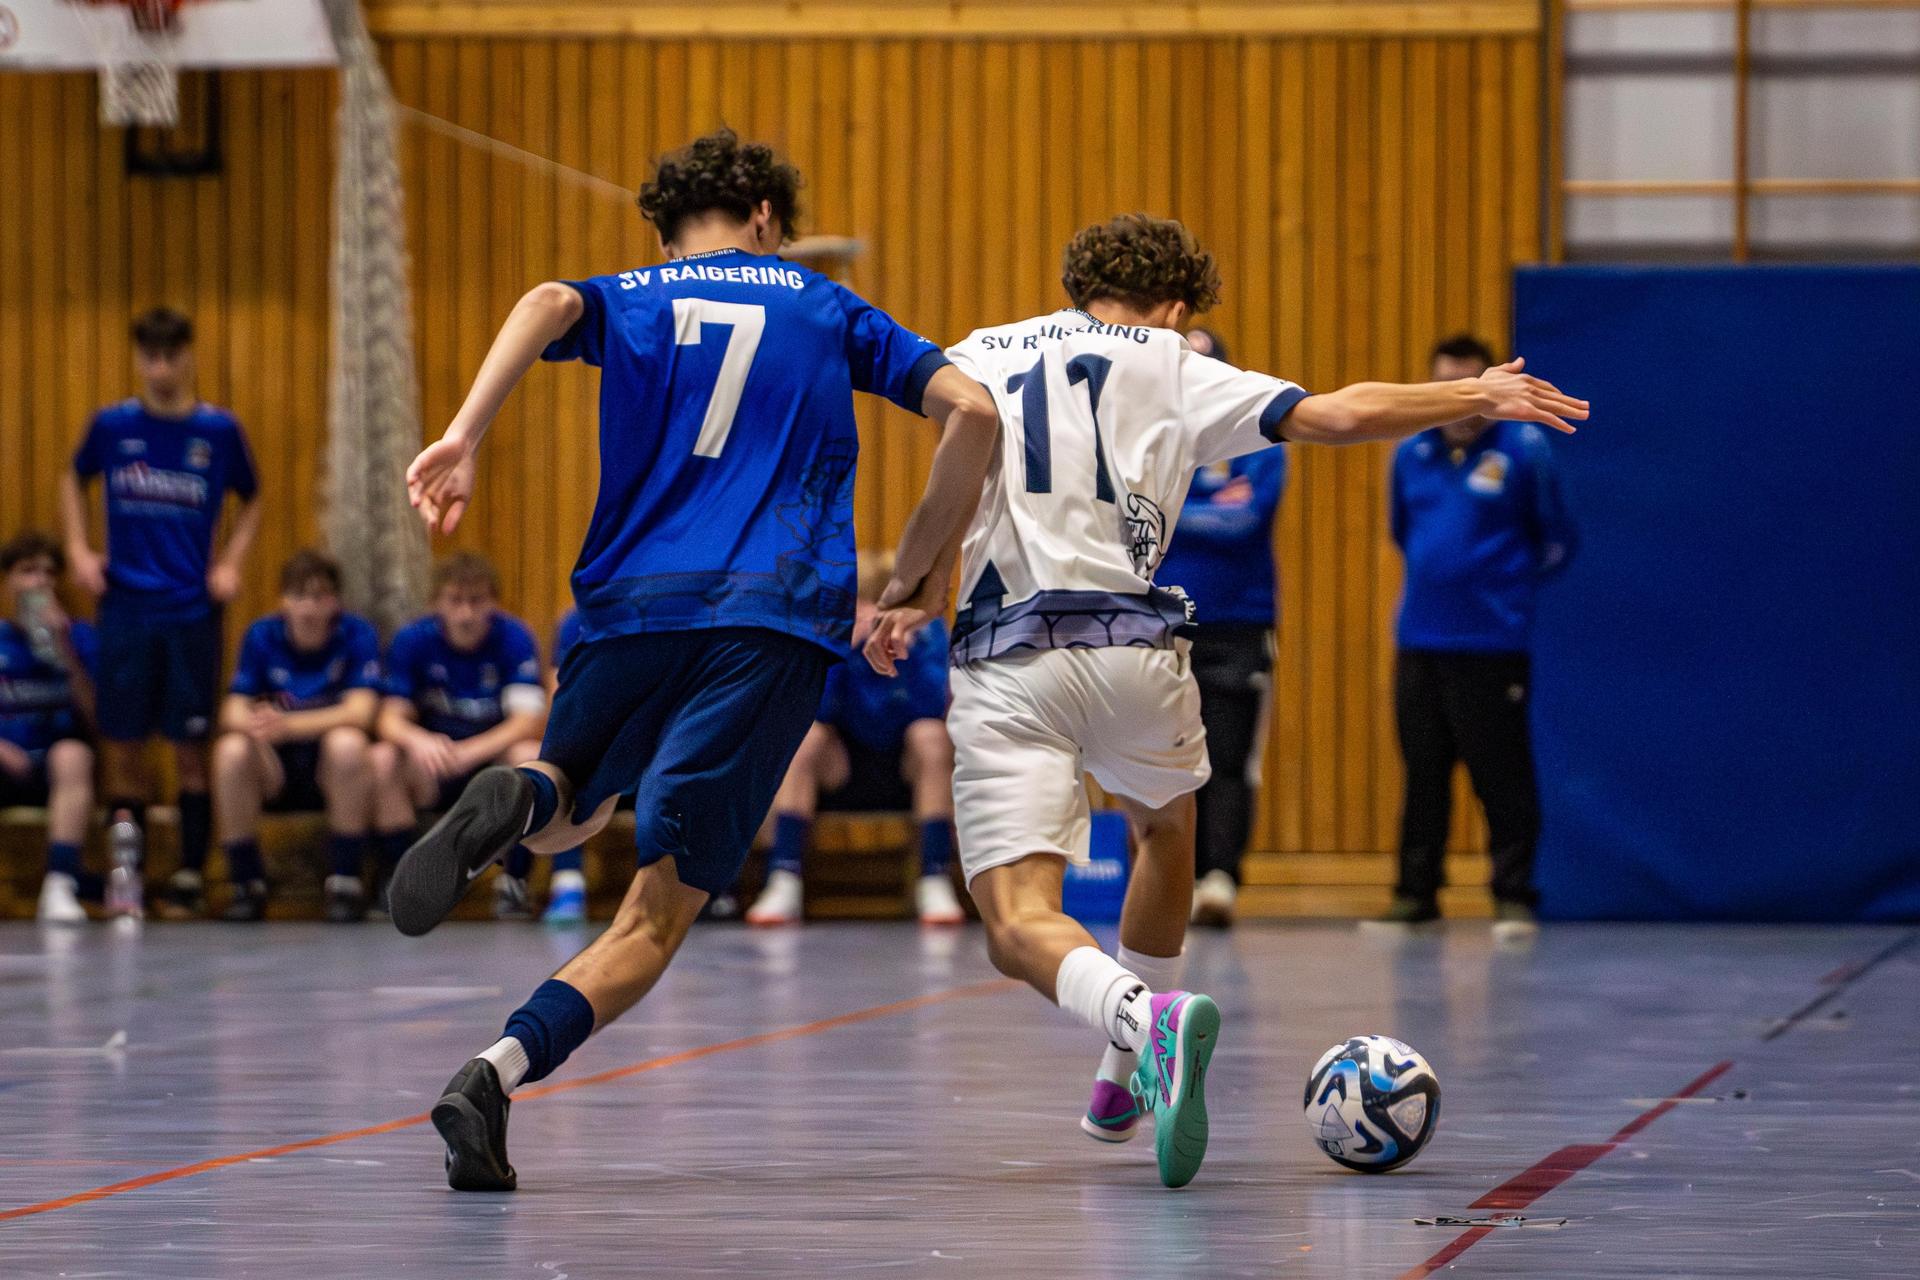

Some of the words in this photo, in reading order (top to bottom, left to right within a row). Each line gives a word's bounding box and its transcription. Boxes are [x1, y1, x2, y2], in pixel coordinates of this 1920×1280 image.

[618, 271, 651, 290] SV
[660, 264, 805, 290] RAIGERING
[672, 297, 765, 458] 7
[981, 335, 1013, 350] SV
[1006, 352, 1116, 505] 11
